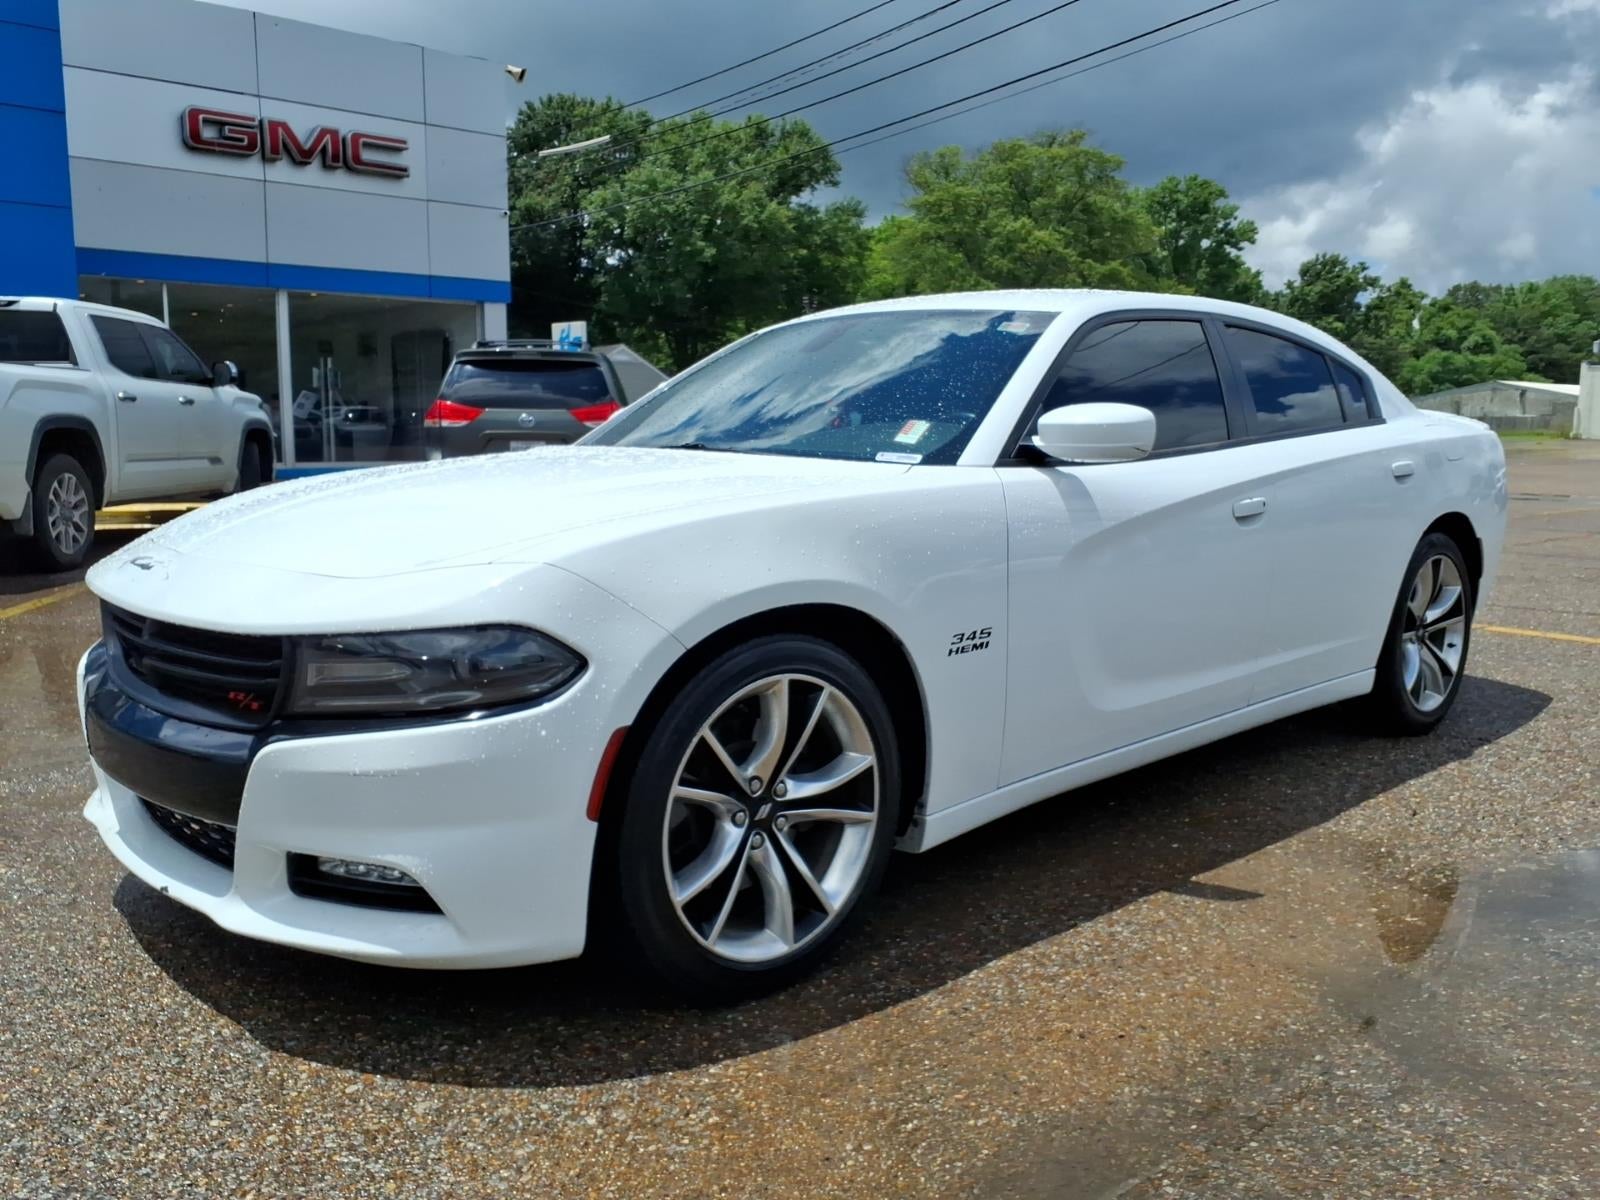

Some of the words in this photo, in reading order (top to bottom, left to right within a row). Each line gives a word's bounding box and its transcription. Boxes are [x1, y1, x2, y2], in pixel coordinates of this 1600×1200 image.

[181, 105, 410, 177] GMC
[951, 627, 992, 645] 345
[948, 640, 990, 657] HEMI
